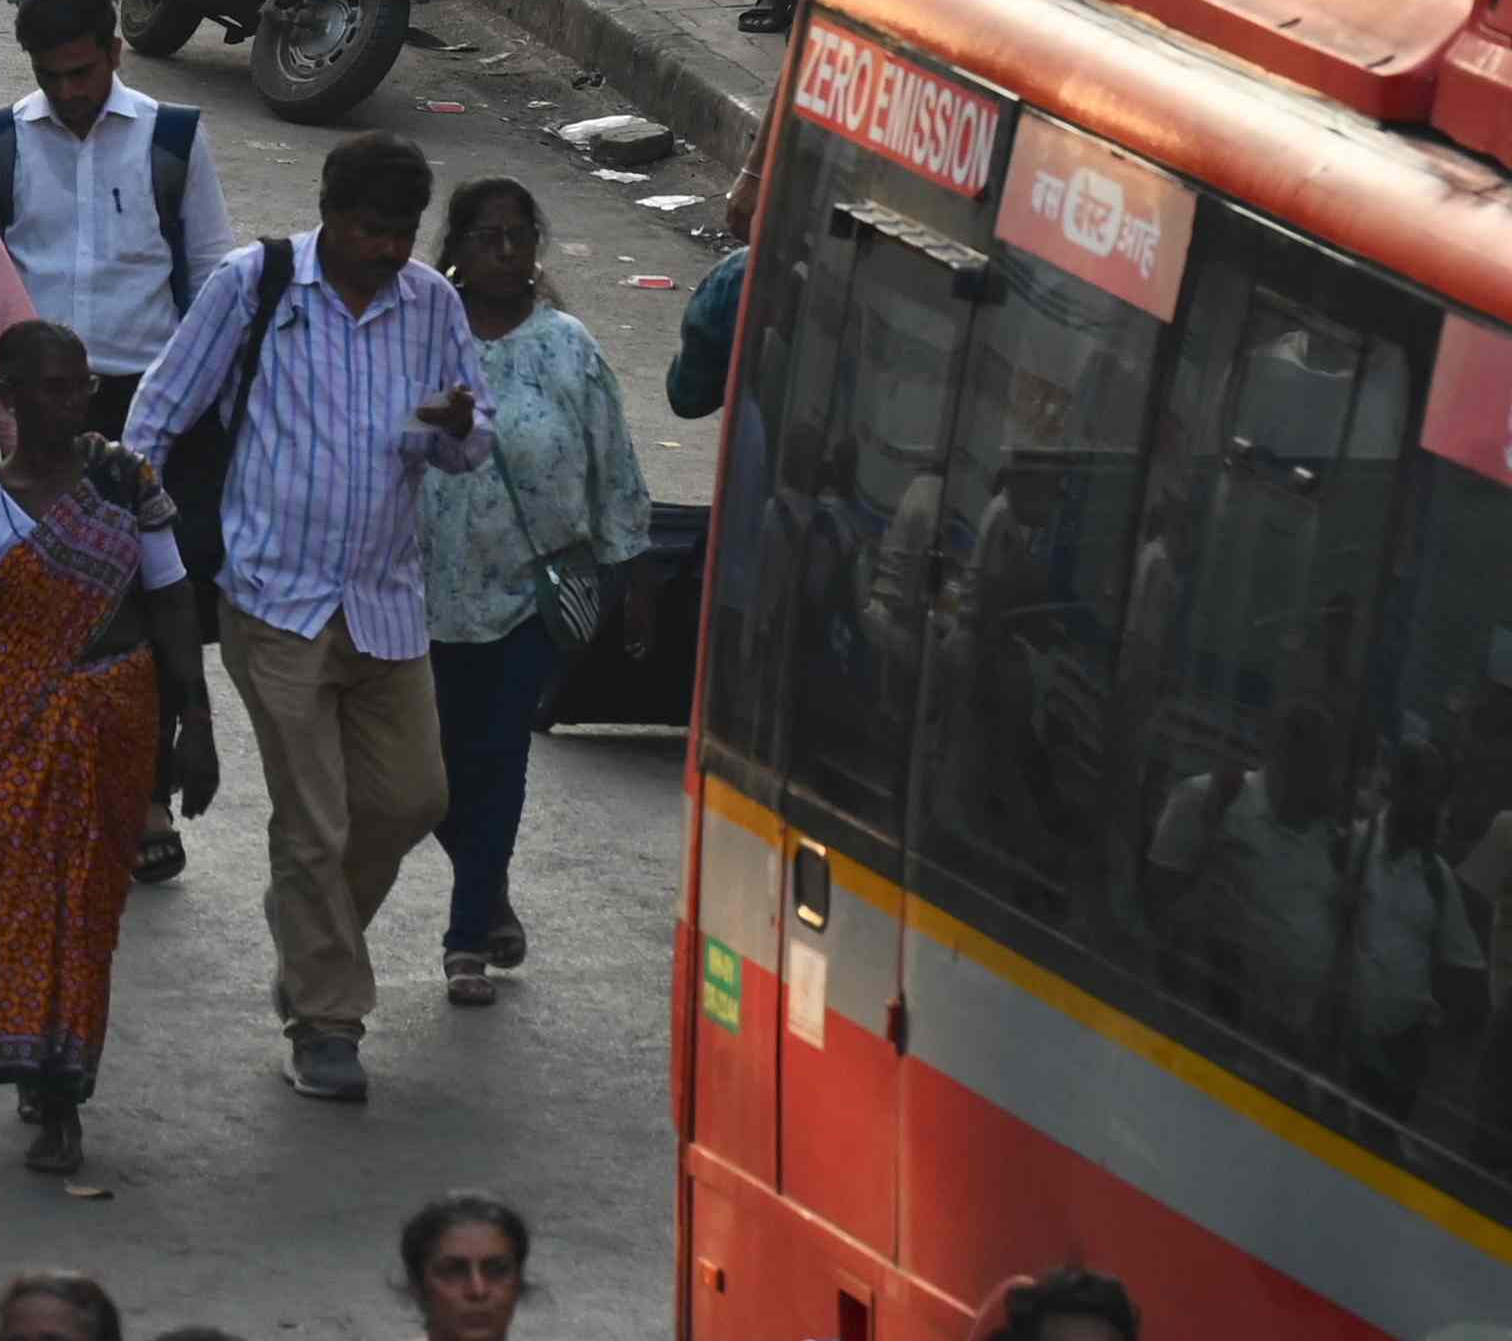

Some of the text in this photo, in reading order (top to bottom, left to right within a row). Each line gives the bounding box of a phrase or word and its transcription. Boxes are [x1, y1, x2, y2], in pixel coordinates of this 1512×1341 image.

[795, 25, 1000, 190] ZERO EMISSION
[1032, 169, 1162, 279] बस बेस्ट आहे
